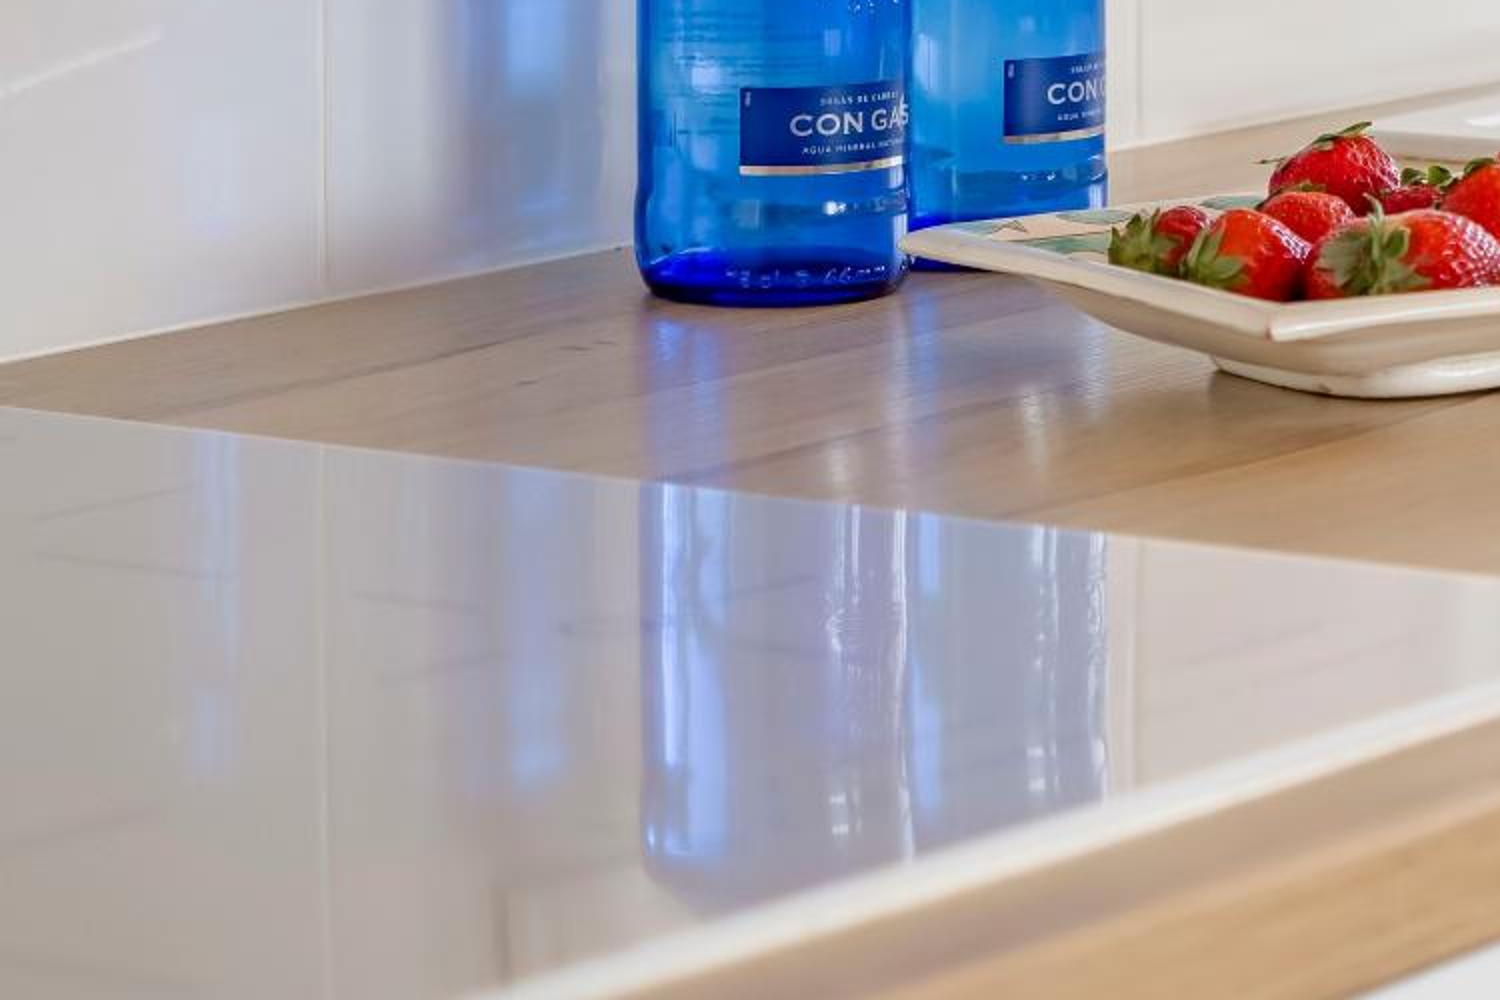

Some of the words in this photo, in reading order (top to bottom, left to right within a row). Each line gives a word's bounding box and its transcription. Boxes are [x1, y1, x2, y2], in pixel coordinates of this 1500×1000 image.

[1047, 79, 1098, 105] CON
[789, 111, 864, 137] CON
[871, 102, 909, 131] GAS
